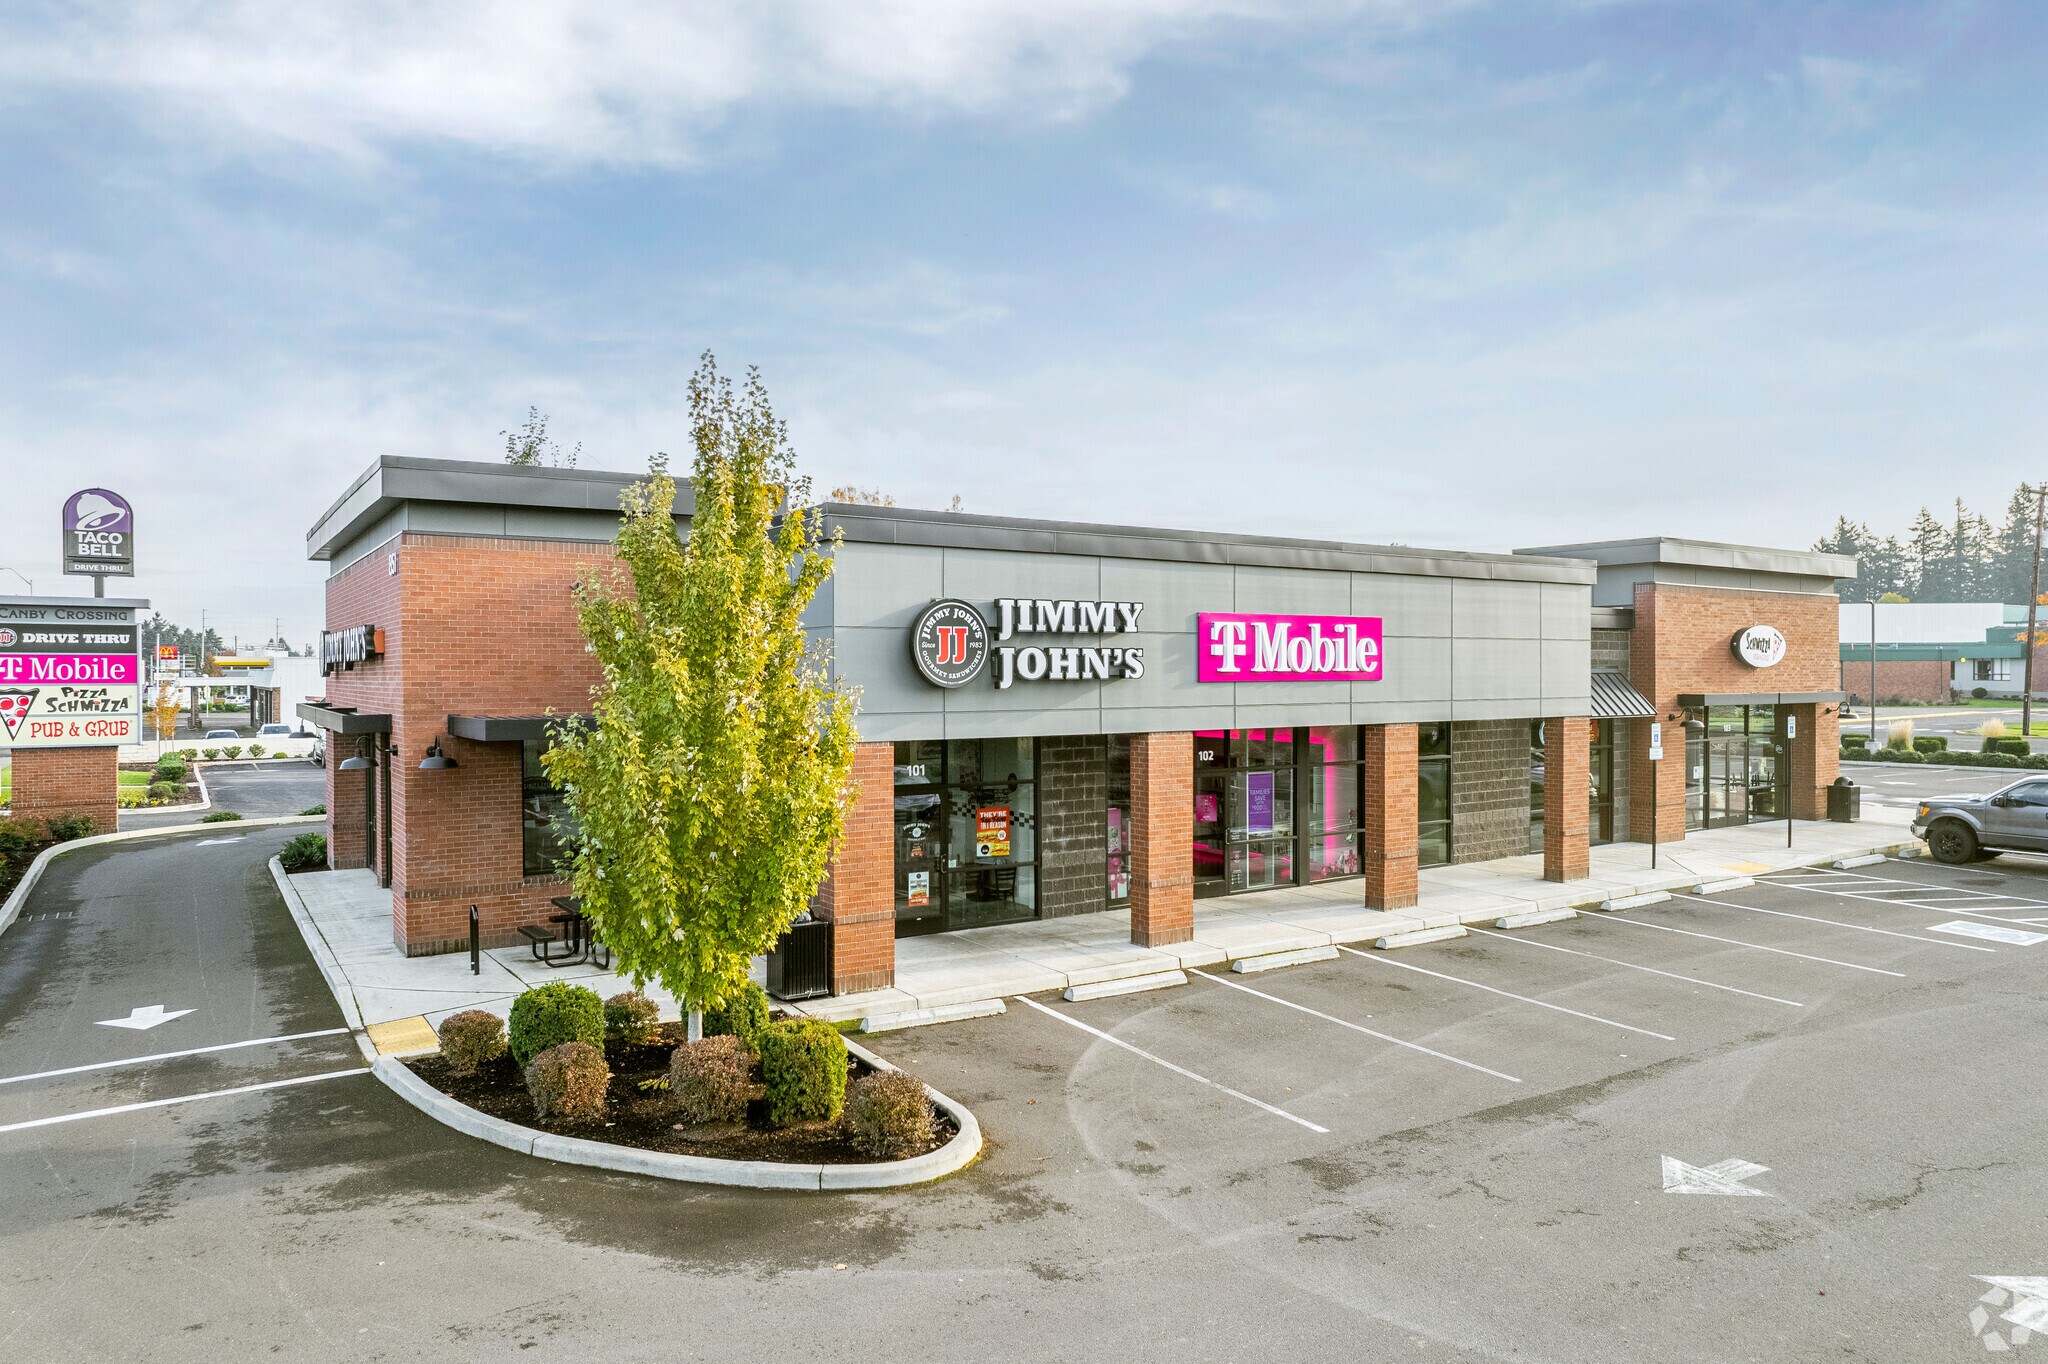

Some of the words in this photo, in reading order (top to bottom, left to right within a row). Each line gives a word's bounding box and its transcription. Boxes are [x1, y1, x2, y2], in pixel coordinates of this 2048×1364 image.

[74, 531, 123, 545] TACO
[78, 543, 122, 557] BELL
[0, 607, 47, 619] CANBY
[55, 609, 128, 620] CROSSING
[922, 607, 951, 639] JIMMY
[953, 608, 983, 639] JOHN'S
[998, 598, 1145, 641] JIMMY
[22, 633, 79, 644] DRIVE
[83, 634, 130, 644] THRU
[936, 626, 969, 664] JJ
[1251, 621, 1378, 673] Mobile
[29, 657, 126, 680] Mobile
[922, 650, 948, 678] GOURMET
[948, 650, 983, 679] SANDWICHES
[998, 646, 1145, 689] JOHN'S
[30, 722, 64, 738] PUB
[69, 722, 80, 737] &
[85, 720, 129, 737] GRUB
[1198, 750, 1214, 761] 102
[907, 764, 926, 777] 101
